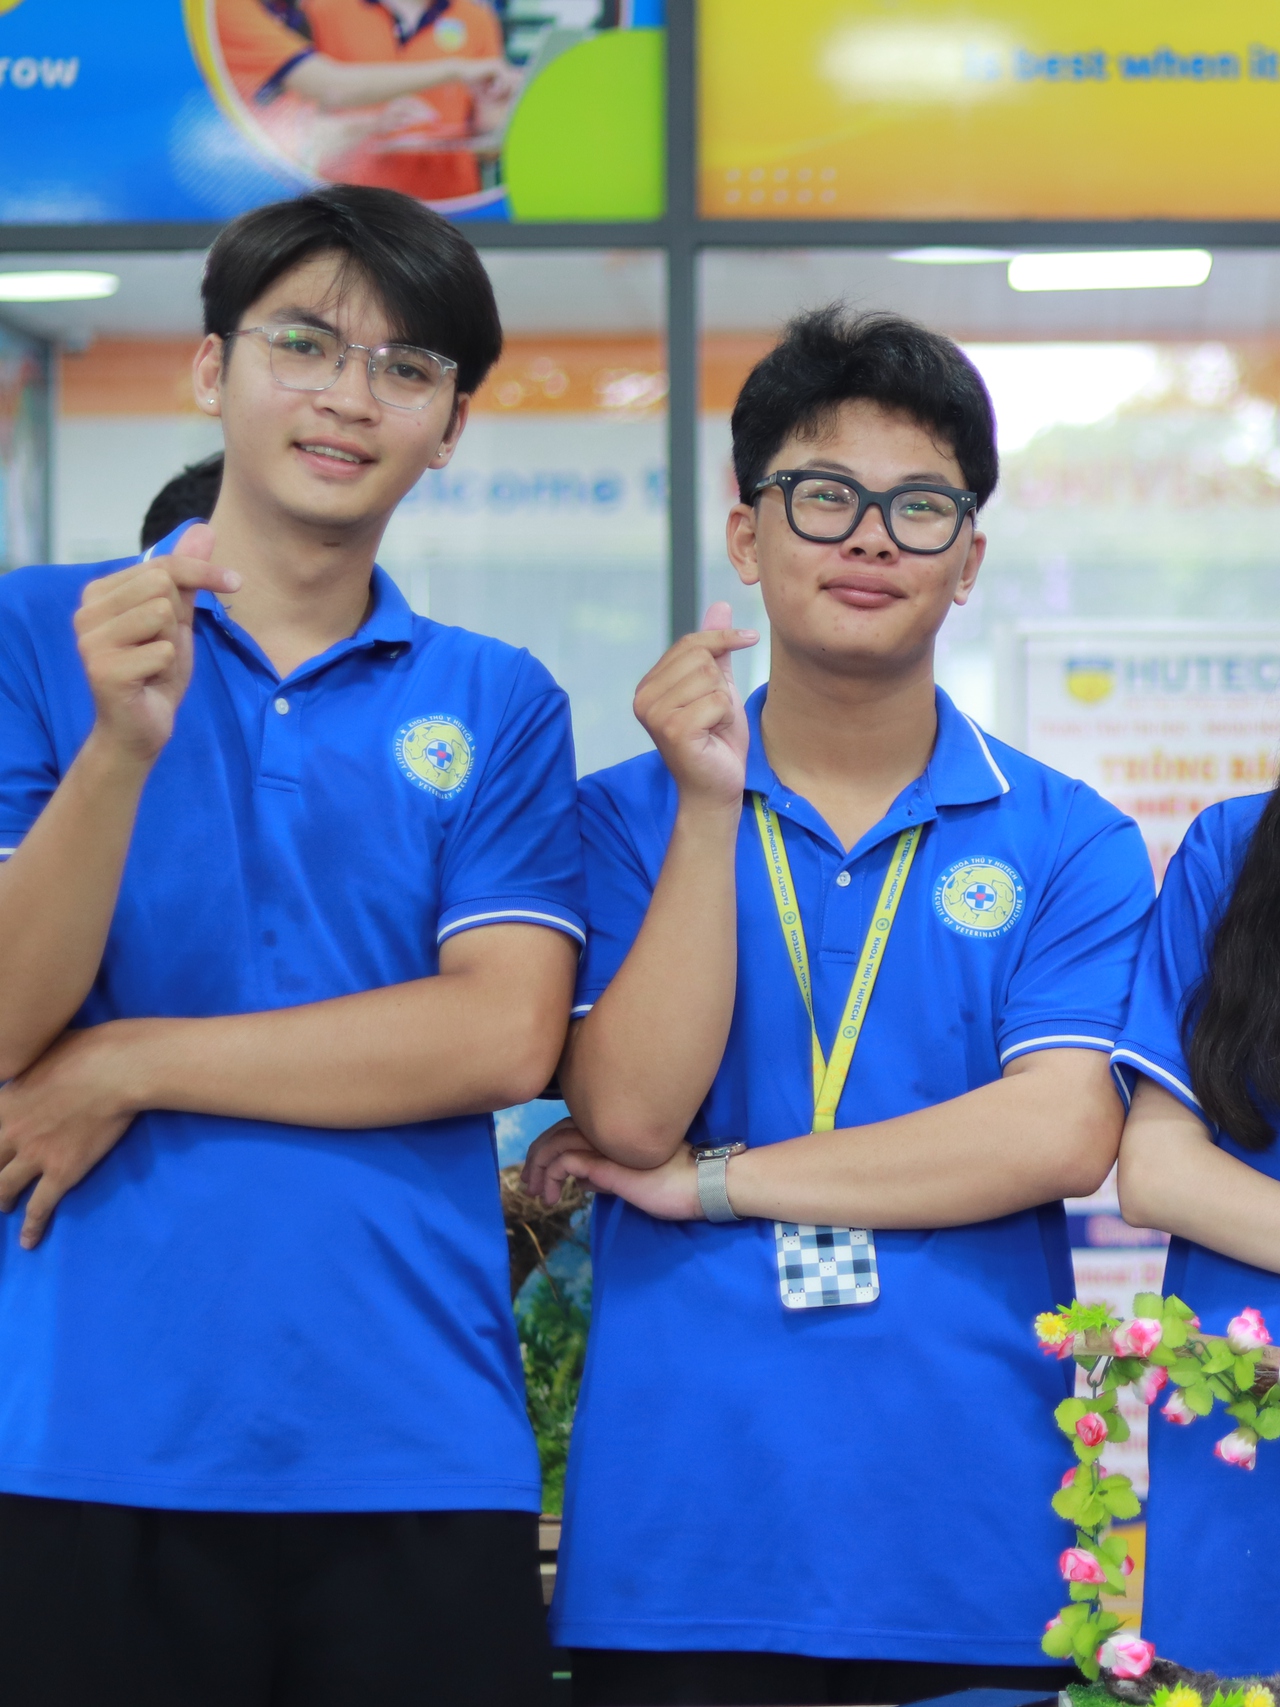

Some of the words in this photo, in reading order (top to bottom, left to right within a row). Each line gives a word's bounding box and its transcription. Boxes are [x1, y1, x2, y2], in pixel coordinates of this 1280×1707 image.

[1011, 45, 1108, 82] best
[1117, 45, 1239, 82] when
[1249, 44, 1280, 82] it
[408, 717, 428, 728] KHOA
[453, 719, 473, 742] HUTECH
[395, 738, 407, 769] FACULTY
[406, 771, 417, 781] OF
[766, 824, 780, 864] VETERINARY
[896, 838, 913, 878] VETERINARY
[775, 865, 782, 874] OF
[949, 860, 969, 873] KHOA
[994, 861, 1018, 881] HUTECH
[778, 875, 790, 906] FACULTY
[884, 878, 898, 911] MEDICINE
[935, 887, 944, 916] FACULTY
[943, 916, 954, 926] OF
[955, 925, 1001, 938] VETERINARY
[1002, 899, 1023, 933] MEDICINE
[790, 929, 803, 963] HUTECH
[869, 937, 881, 960] KHOA
[850, 988, 866, 1021] HUTECH
